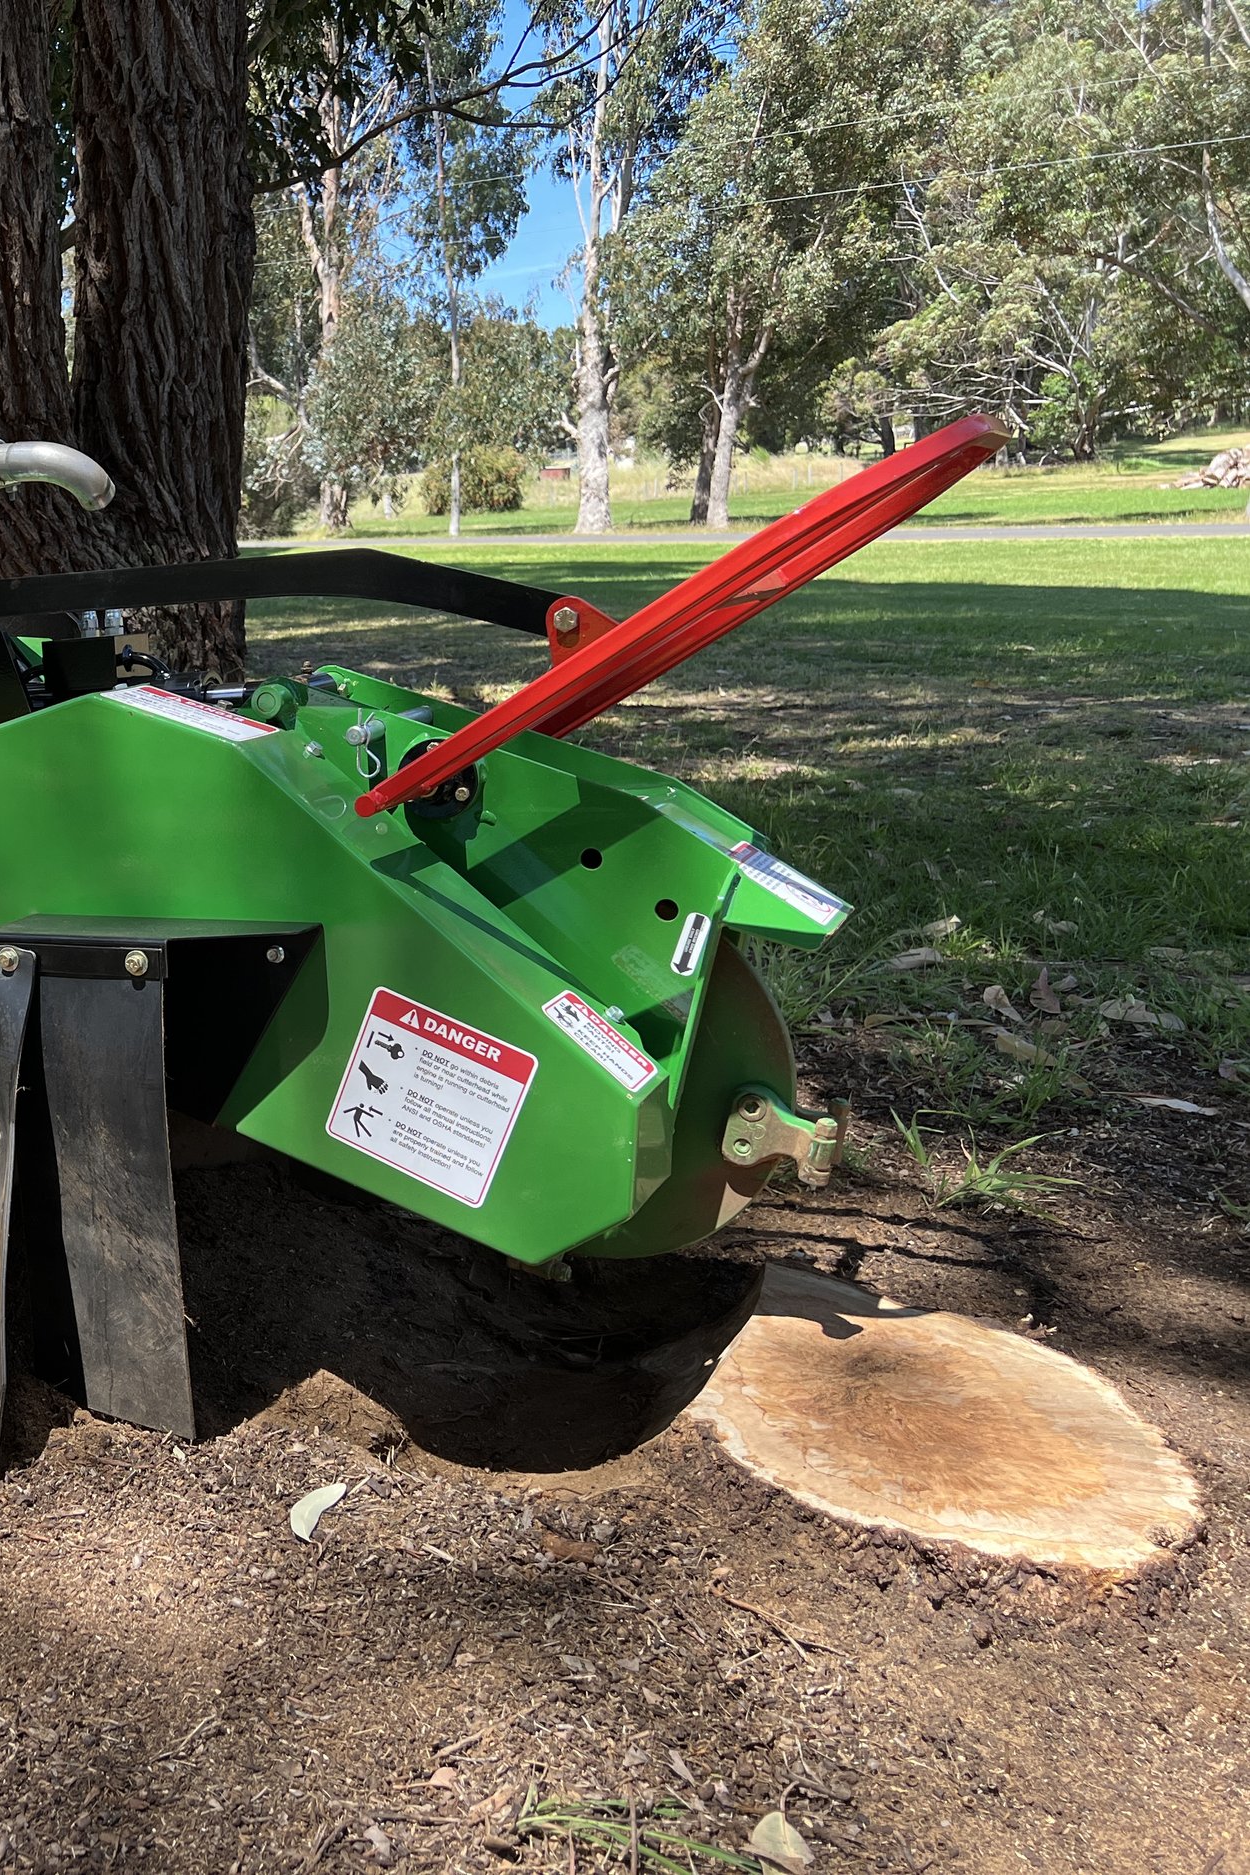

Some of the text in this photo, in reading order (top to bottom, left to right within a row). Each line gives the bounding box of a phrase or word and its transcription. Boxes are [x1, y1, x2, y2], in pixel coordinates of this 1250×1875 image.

[423, 1017, 502, 1062] DANGER
[587, 1022, 621, 1053] MOVING
[589, 1014, 649, 1067] DANGER
[416, 1065, 437, 1079] engine
[445, 1078, 468, 1094] running
[469, 1089, 476, 1097] or
[477, 1093, 510, 1113] cutterhead
[420, 1075, 444, 1091] turning!
[422, 1049, 499, 1090] DO NOT go within debris
[441, 1067, 456, 1078] near
[457, 1074, 491, 1095] cutterhead
[491, 1090, 508, 1103] while
[402, 1104, 418, 1115] ANSI
[419, 1112, 431, 1122] and
[432, 1119, 452, 1132] OSHA
[405, 1097, 422, 1109] follow
[423, 1105, 431, 1113] all
[432, 1110, 455, 1125] manual
[406, 1089, 493, 1135] DO NOT operate unless you
[392, 1129, 484, 1177] are properly trained and follow
[395, 1121, 480, 1167] DO NOT operate unless you
[398, 1141, 417, 1154] safety
